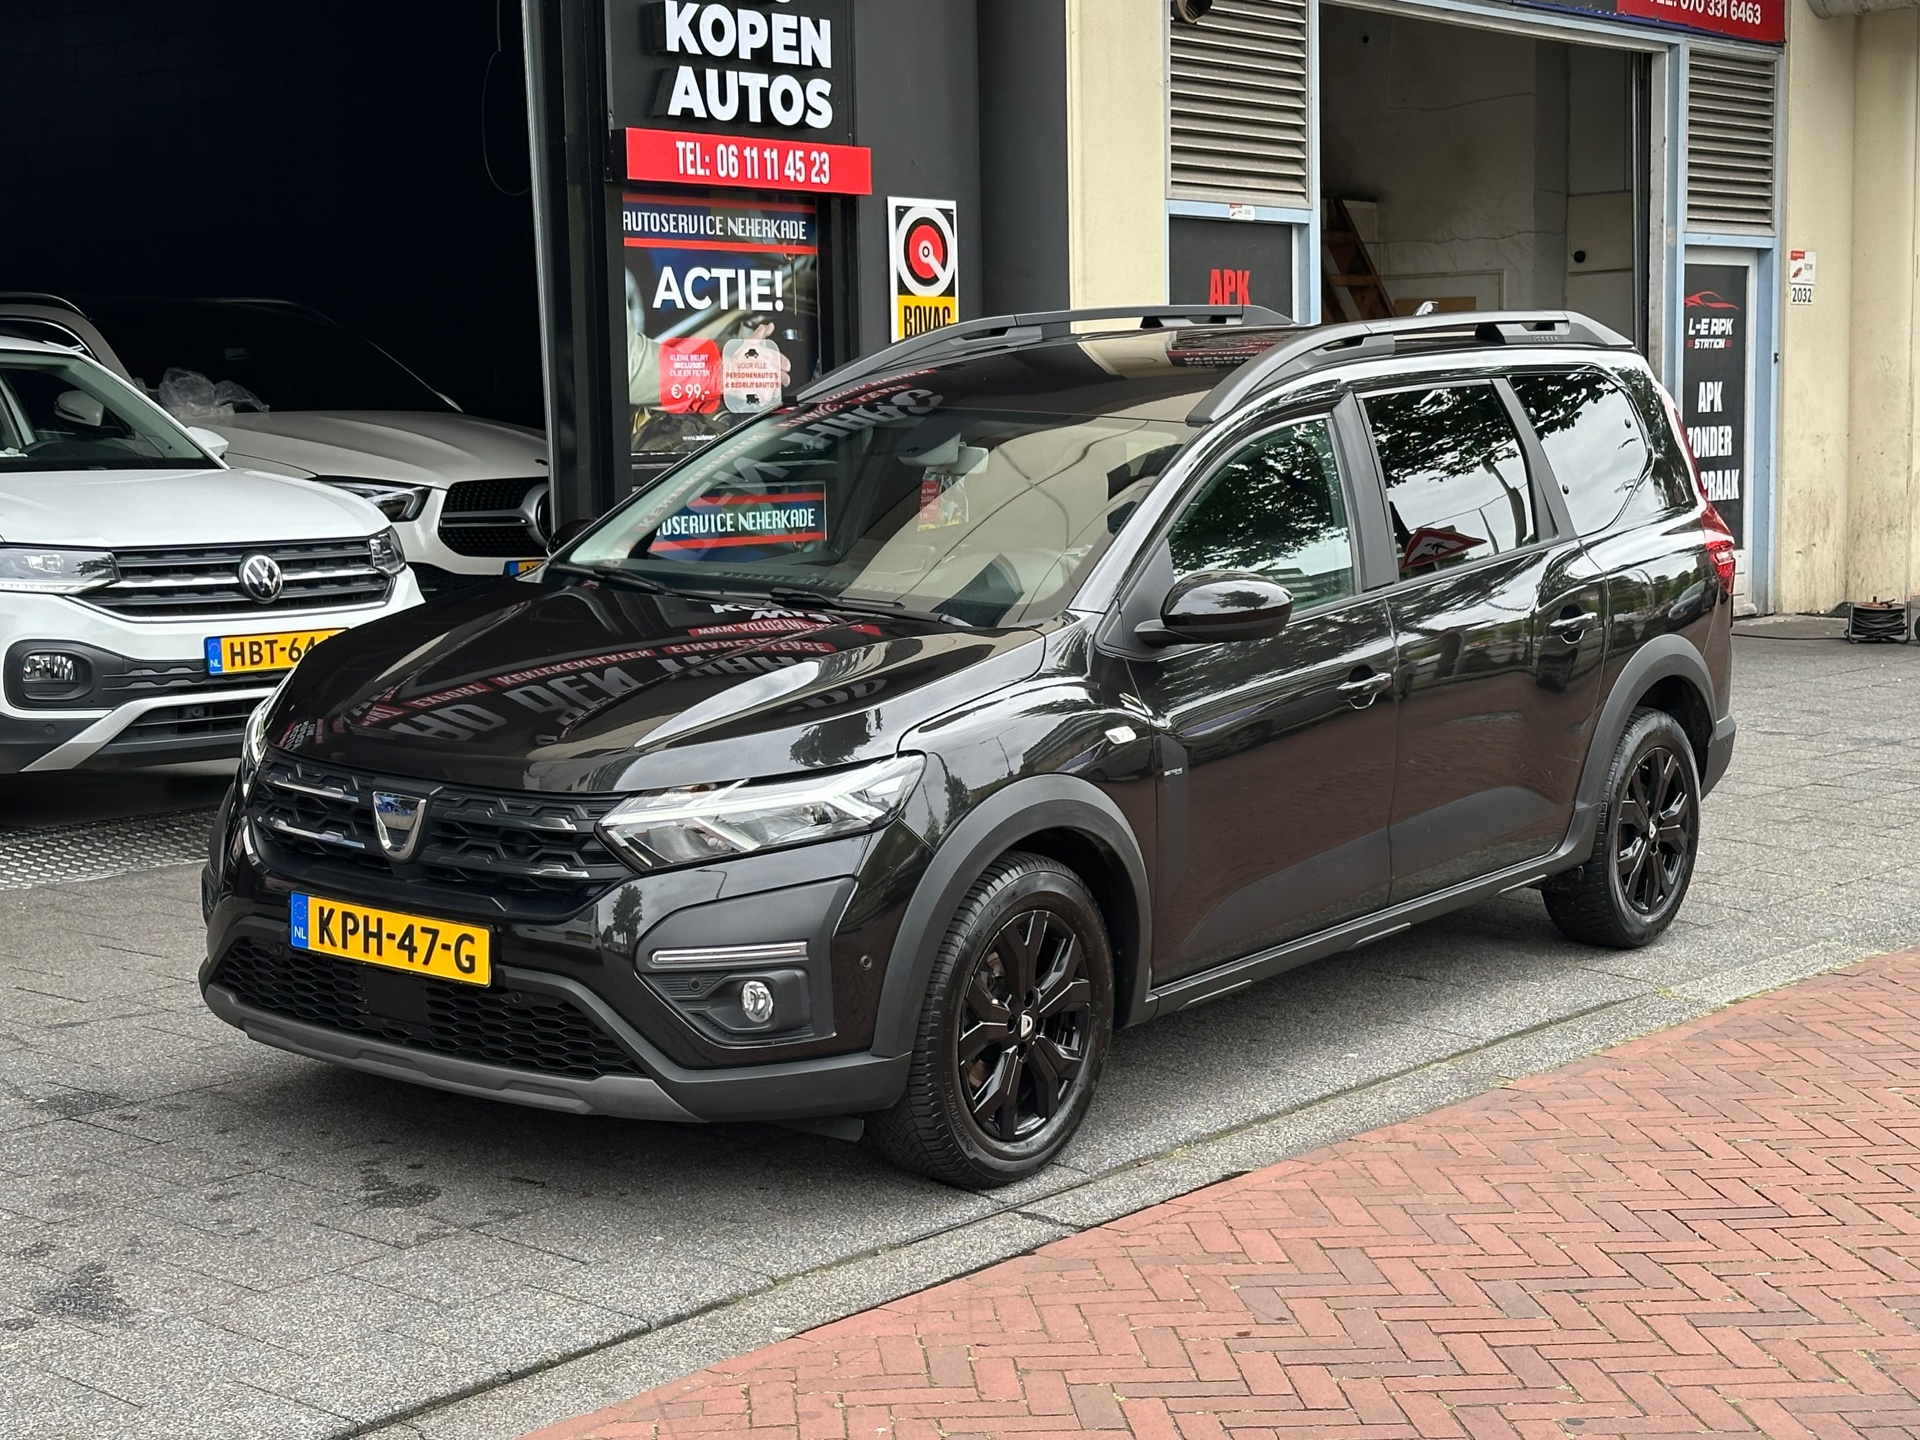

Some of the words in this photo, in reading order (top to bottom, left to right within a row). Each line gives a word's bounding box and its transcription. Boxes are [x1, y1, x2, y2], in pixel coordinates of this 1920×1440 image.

[1707, 0, 1728, 18] 331
[1730, 1, 1761, 25] 6463
[665, 0, 832, 69] KOPEN
[667, 65, 834, 129] AUTOS
[676, 140, 711, 176] TEL:
[716, 144, 738, 178] 06
[743, 147, 760, 180] 11
[763, 148, 780, 181] 11
[784, 149, 805, 183] 45
[810, 151, 831, 184] 23
[623, 210, 724, 236] AUTOSERVICE
[727, 215, 807, 241] NEHERKADE
[652, 265, 785, 312] ACTIE!
[1209, 268, 1251, 306] APK
[1792, 287, 1812, 303] 2032
[1710, 317, 1734, 335] APK
[1694, 338, 1726, 349] STATION
[671, 384, 683, 399] €
[685, 383, 711, 401] 99,-
[1698, 381, 1723, 413] APK
[1686, 425, 1733, 458] ZONDER
[738, 508, 816, 531] NEHERKADE
[210, 659, 222, 668] NL
[294, 925, 307, 940] NL
[318, 905, 476, 975] KPH-47-G
